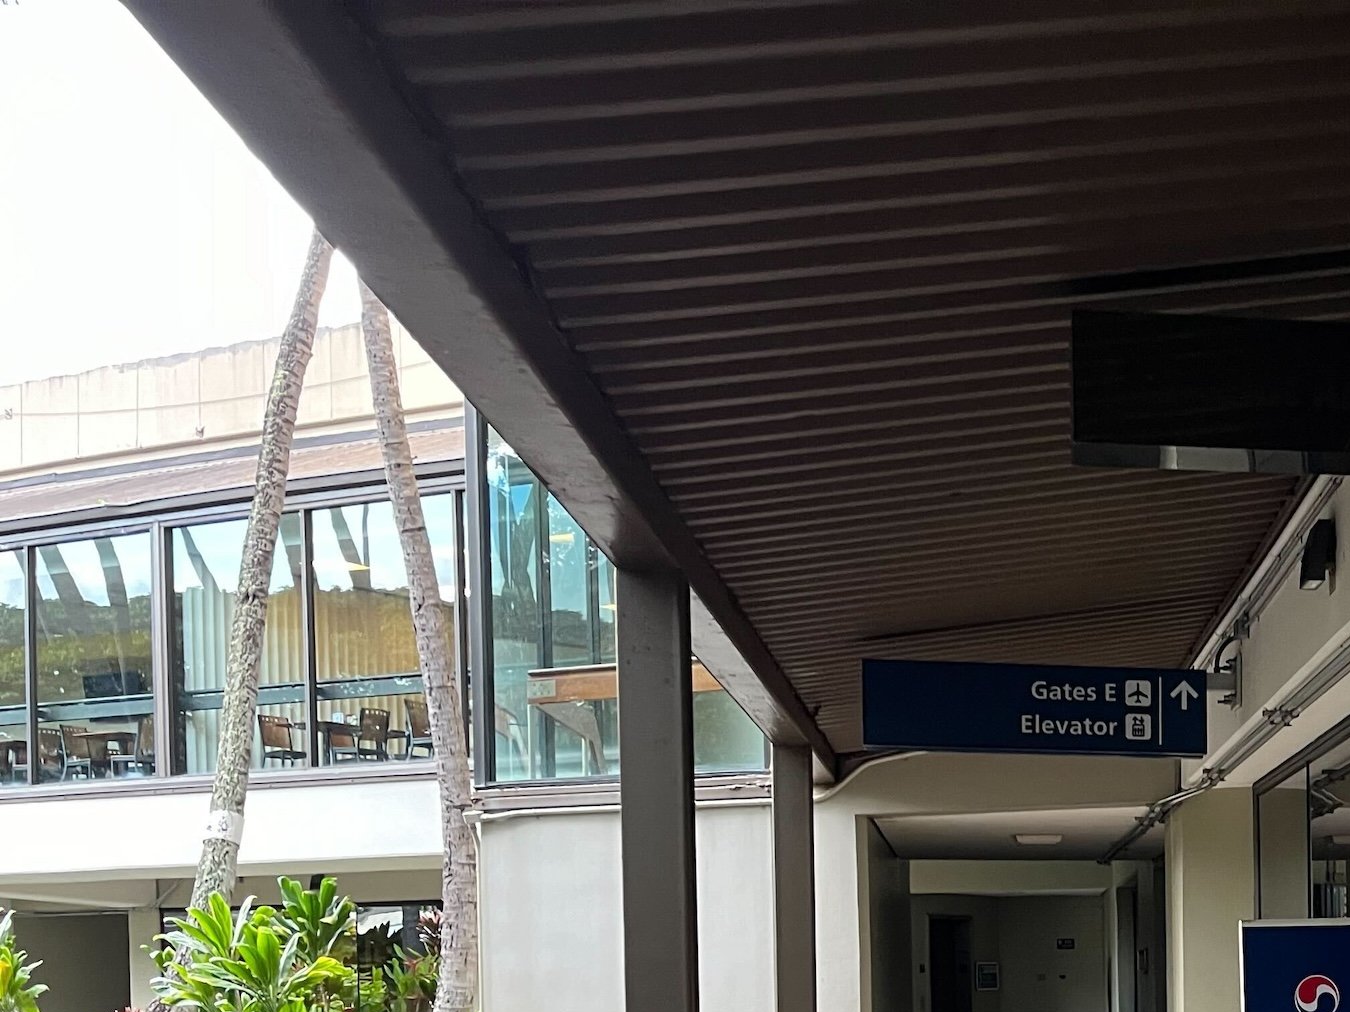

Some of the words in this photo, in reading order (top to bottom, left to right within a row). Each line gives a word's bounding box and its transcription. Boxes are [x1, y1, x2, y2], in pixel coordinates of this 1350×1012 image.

[1031, 680, 1097, 702] Gates
[1105, 682, 1117, 702] E
[1021, 714, 1118, 736] Elevator
